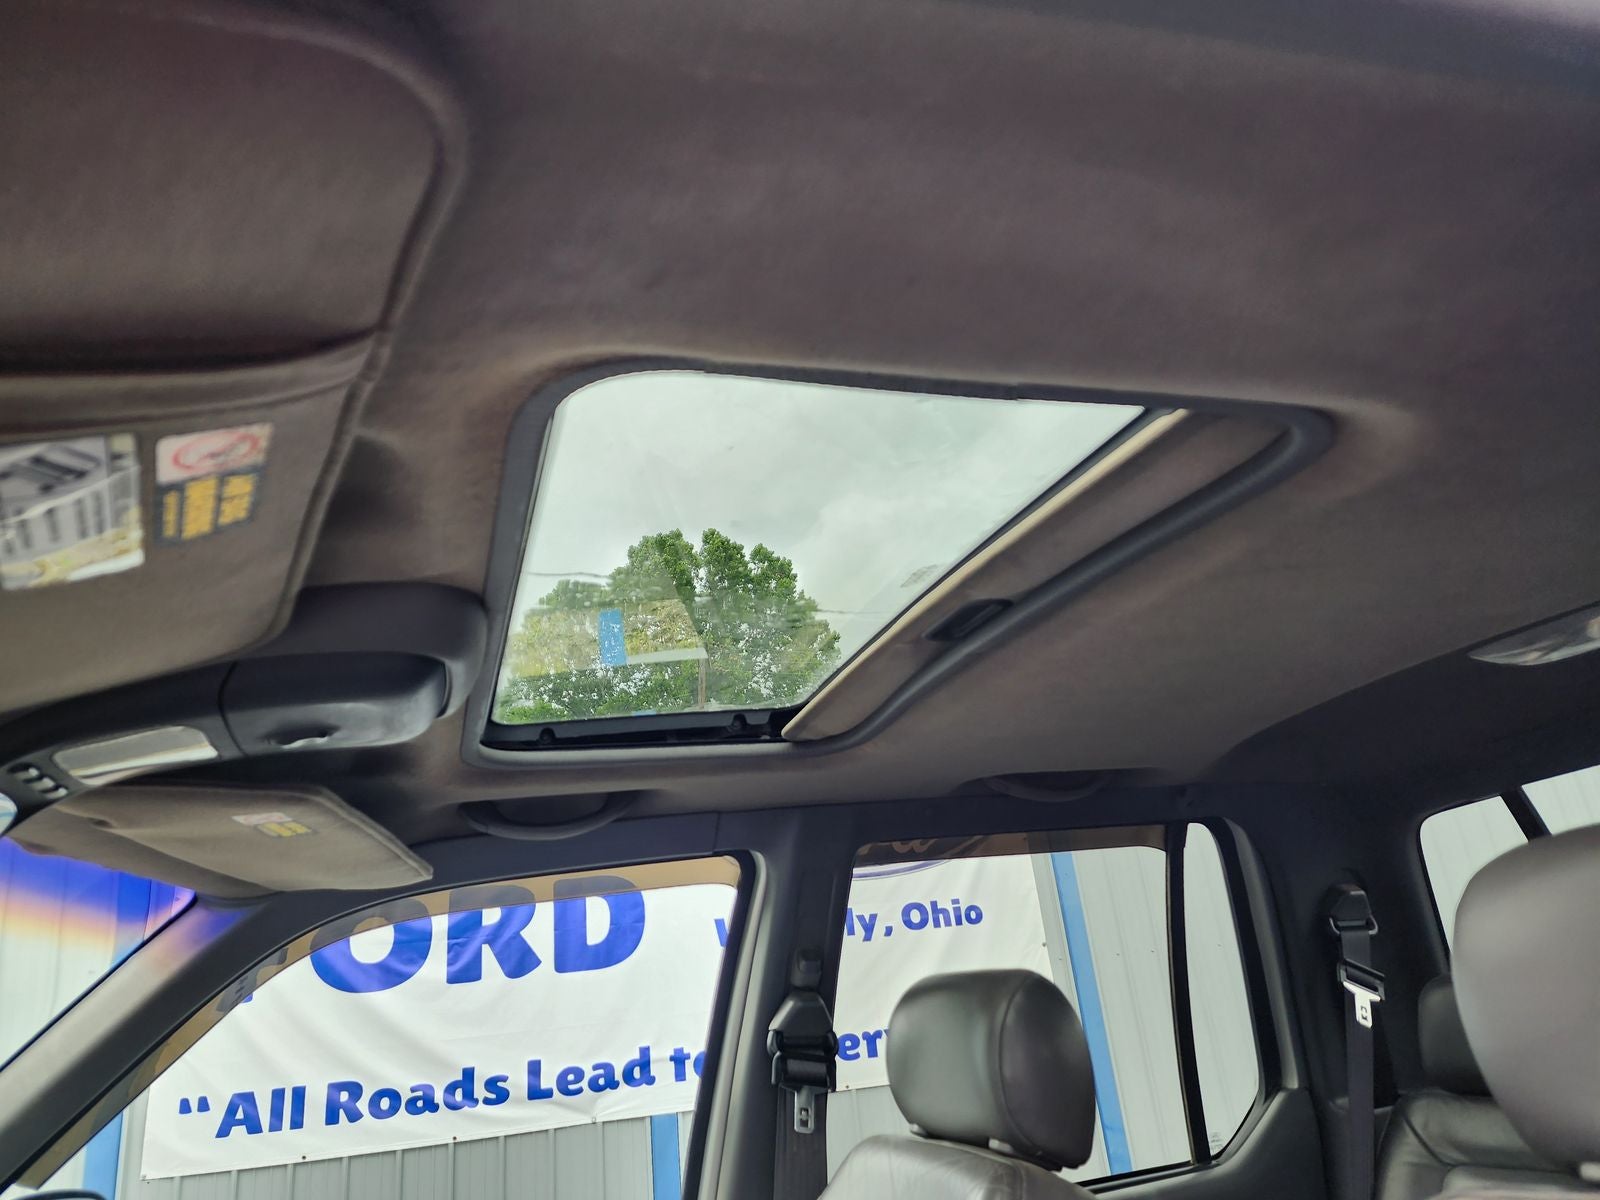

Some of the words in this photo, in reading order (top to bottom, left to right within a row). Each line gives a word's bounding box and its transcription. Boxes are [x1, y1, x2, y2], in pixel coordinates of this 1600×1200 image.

[901, 899, 983, 931] Ohio
[325, 1067, 511, 1126] Roads
[527, 1045, 656, 1101] Lead
[837, 1028, 890, 1061] er
